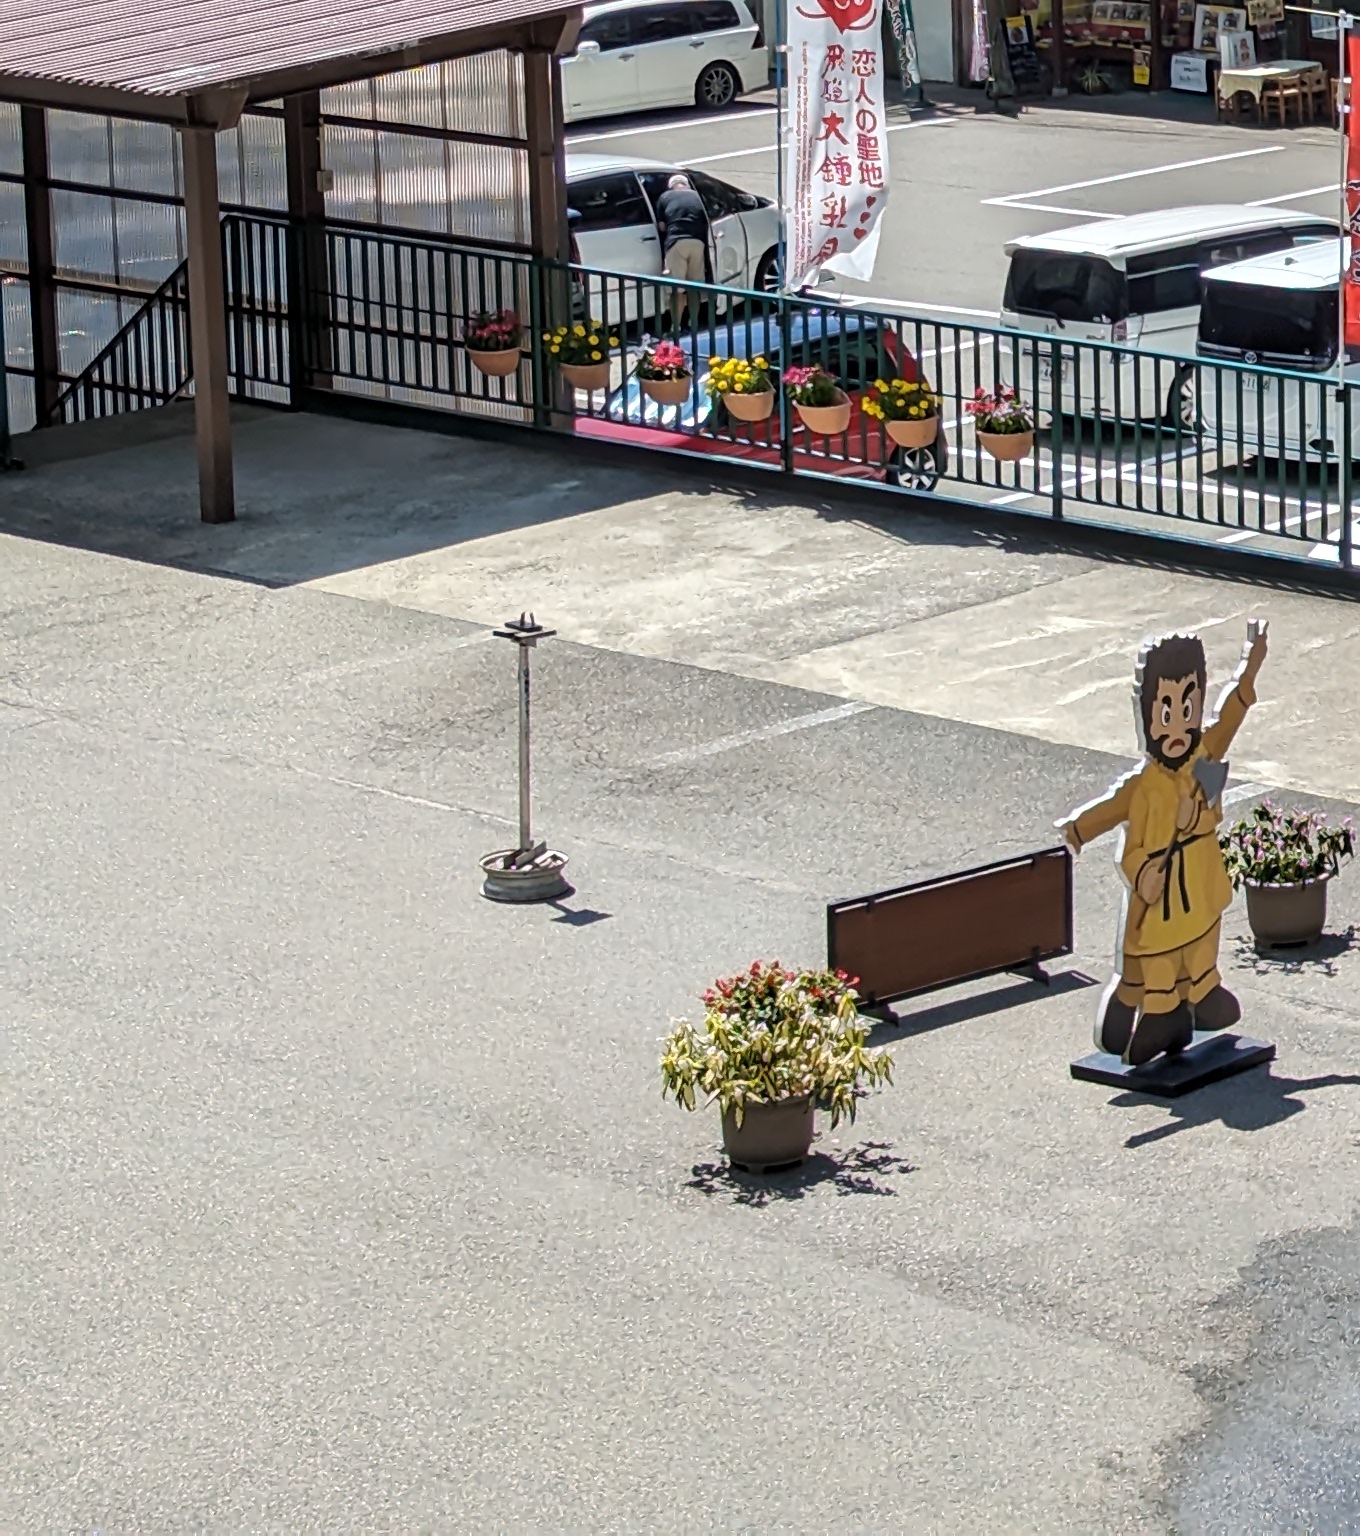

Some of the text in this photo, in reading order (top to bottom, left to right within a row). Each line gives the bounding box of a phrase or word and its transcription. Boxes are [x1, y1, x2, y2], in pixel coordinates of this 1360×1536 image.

[851, 48, 885, 189] 恋人の聖地
